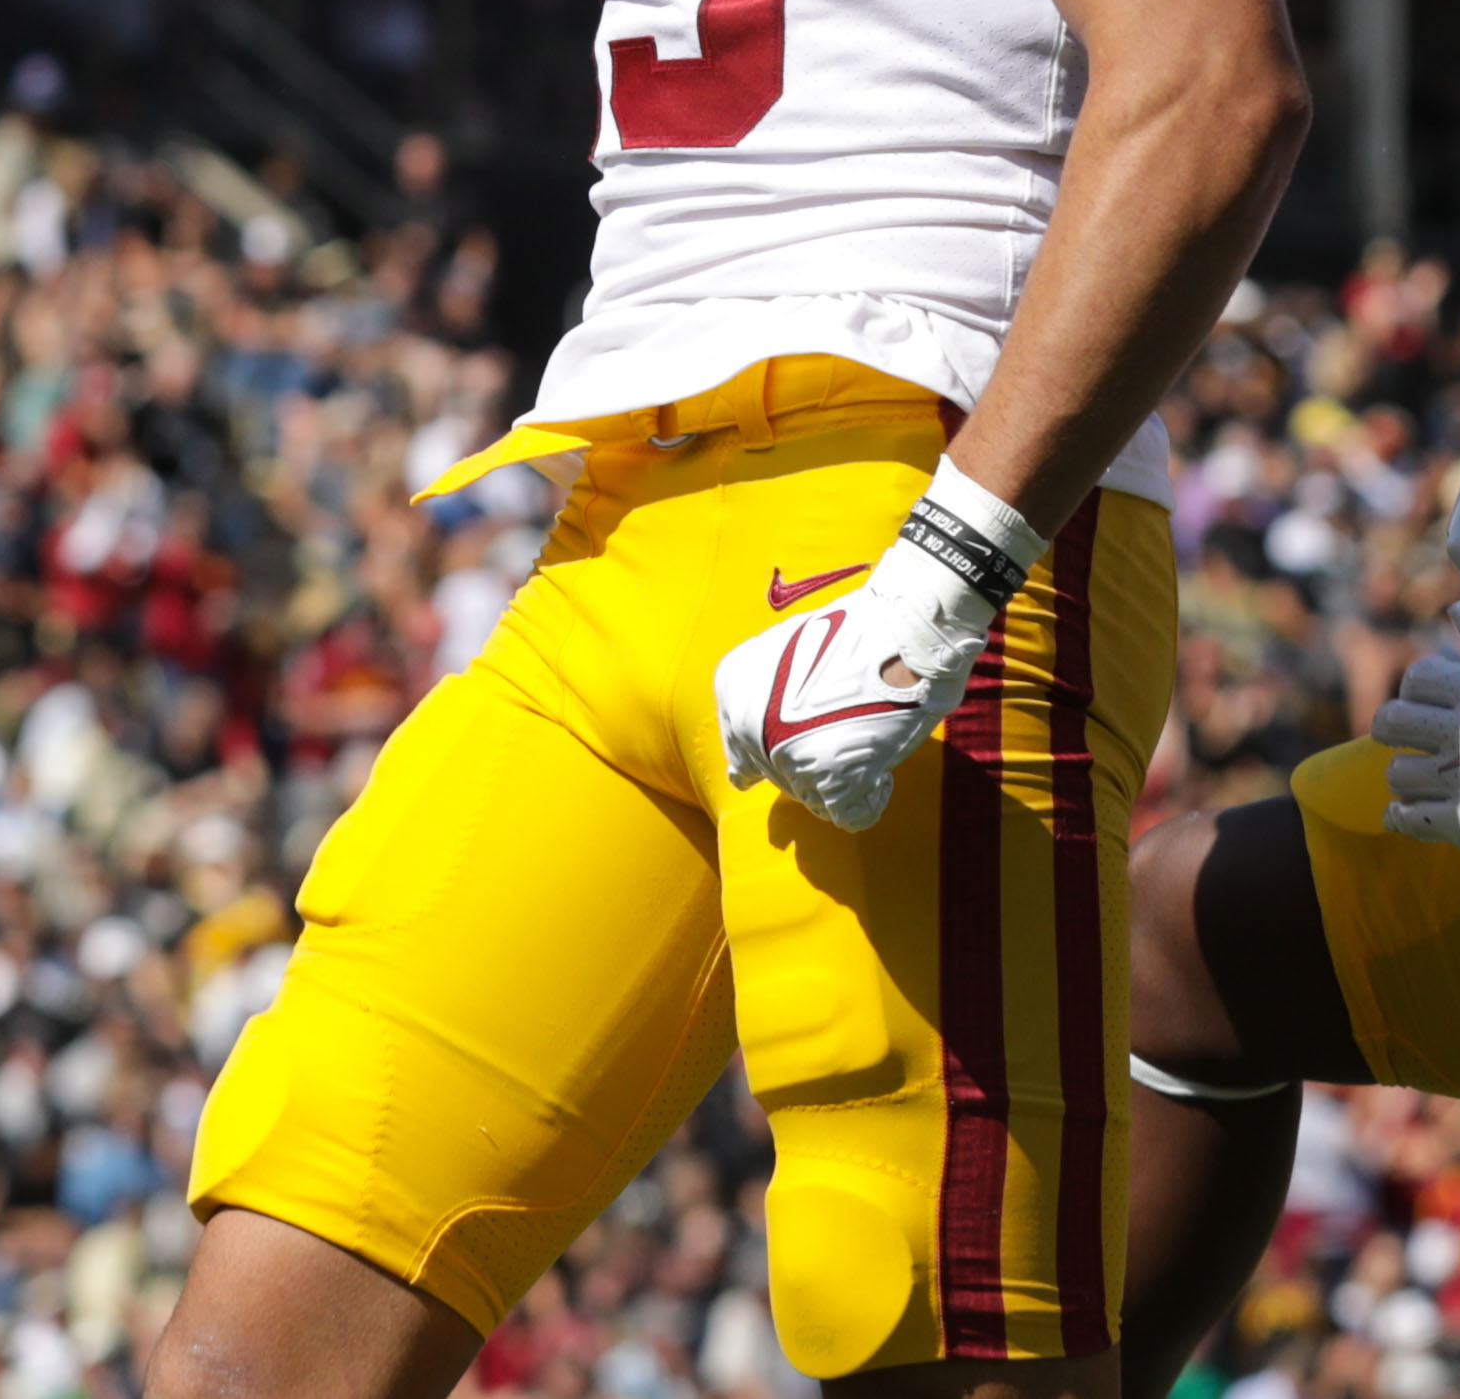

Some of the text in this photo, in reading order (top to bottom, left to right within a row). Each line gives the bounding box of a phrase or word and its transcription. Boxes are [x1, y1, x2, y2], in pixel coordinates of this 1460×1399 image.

[925, 508, 964, 537] FIGHT
[922, 534, 945, 552] ON
[940, 545, 985, 583] FIGHT
